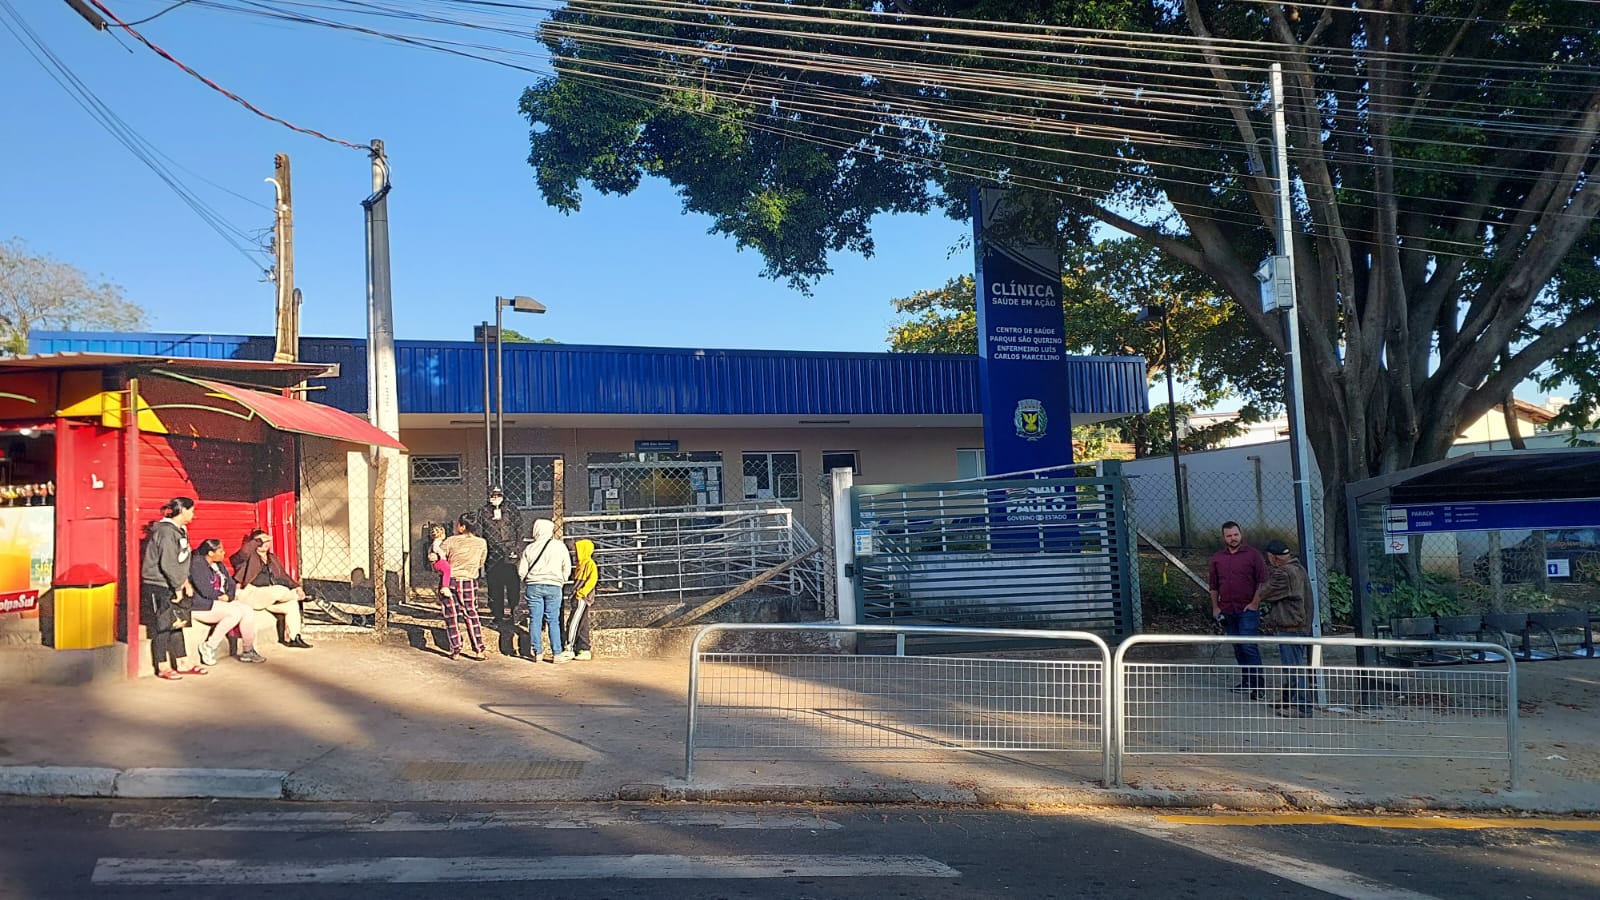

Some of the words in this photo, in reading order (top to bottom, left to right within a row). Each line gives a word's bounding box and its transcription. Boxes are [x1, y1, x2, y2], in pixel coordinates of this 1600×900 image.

[991, 280, 1055, 298] CLÍNICA
[992, 296, 1019, 306] SAÚDE
[1034, 298, 1056, 308] AÇÃO
[995, 326, 1022, 334] CENTRO
[1034, 327, 1056, 335] SAÚDE
[989, 335, 1017, 344] PARQUE
[1018, 335, 1032, 343] SÃO
[1006, 514, 1035, 522] GOVERNO
